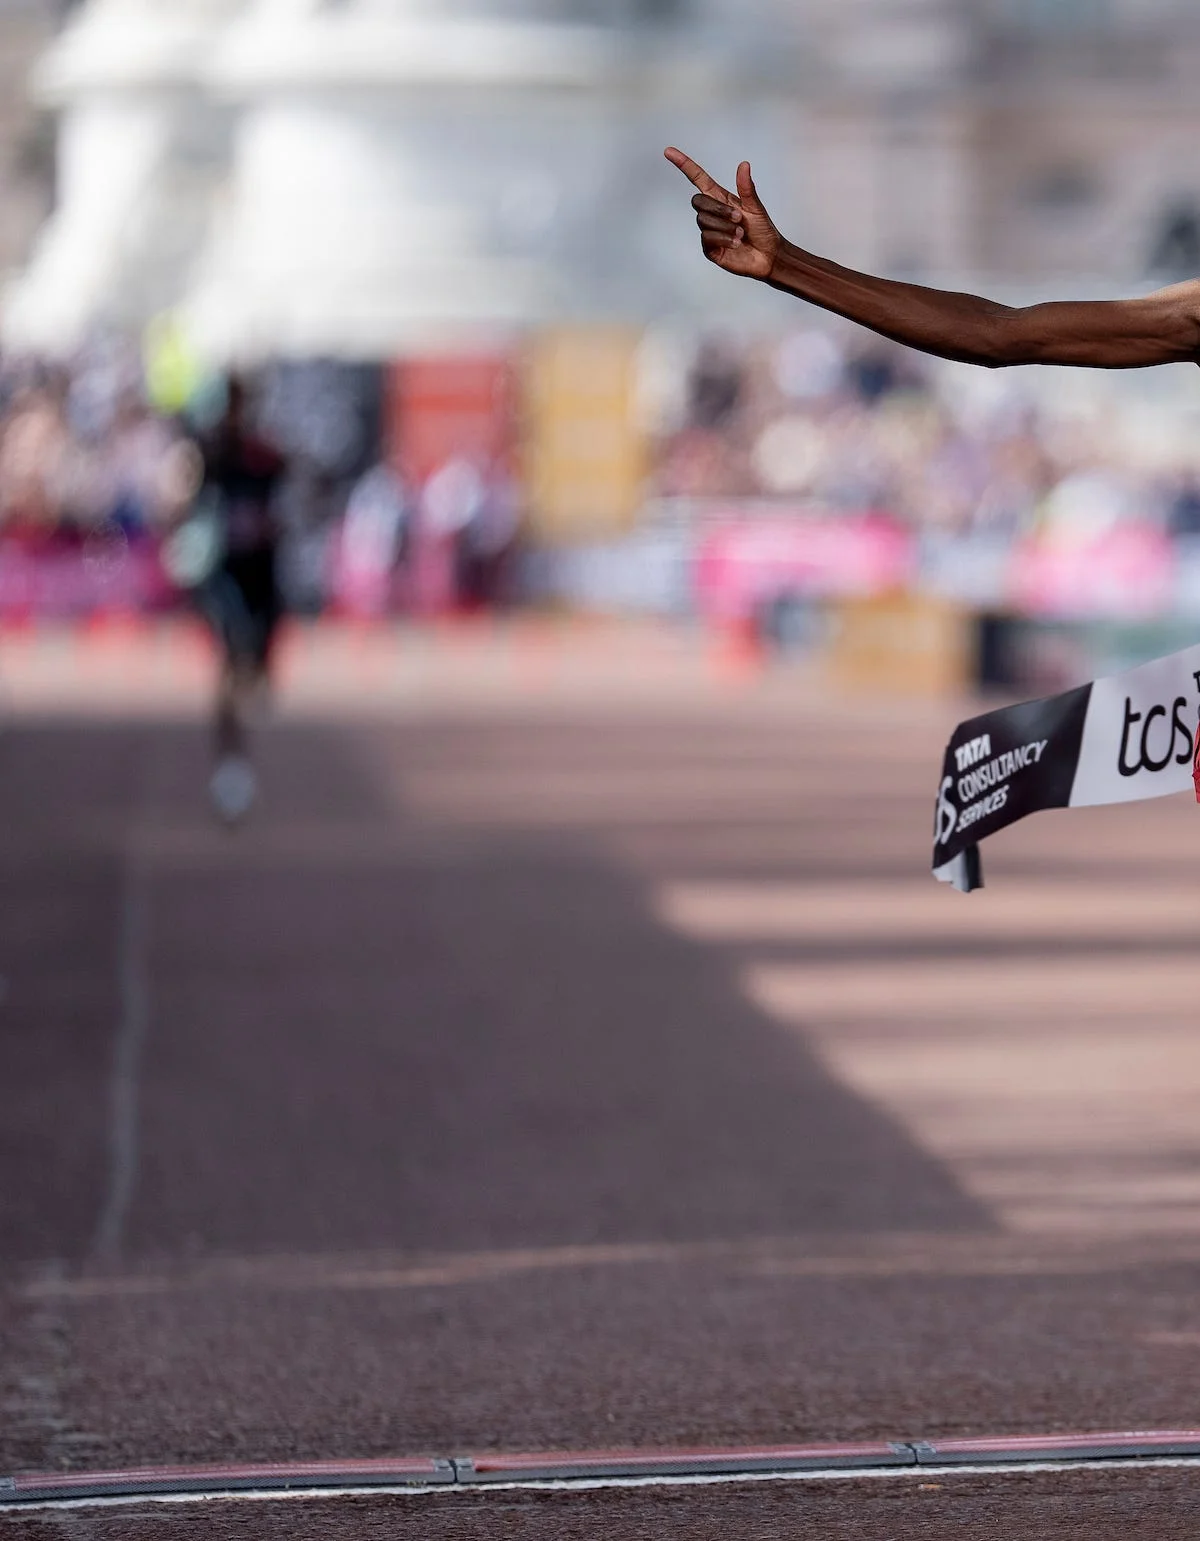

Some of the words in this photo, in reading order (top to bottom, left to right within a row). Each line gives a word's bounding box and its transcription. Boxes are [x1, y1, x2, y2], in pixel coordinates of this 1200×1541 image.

[954, 733, 991, 772] TATA
[1118, 696, 1193, 777] tcs
[958, 739, 1048, 802] CONSULTANCY
[955, 784, 1009, 833] SERVICES
